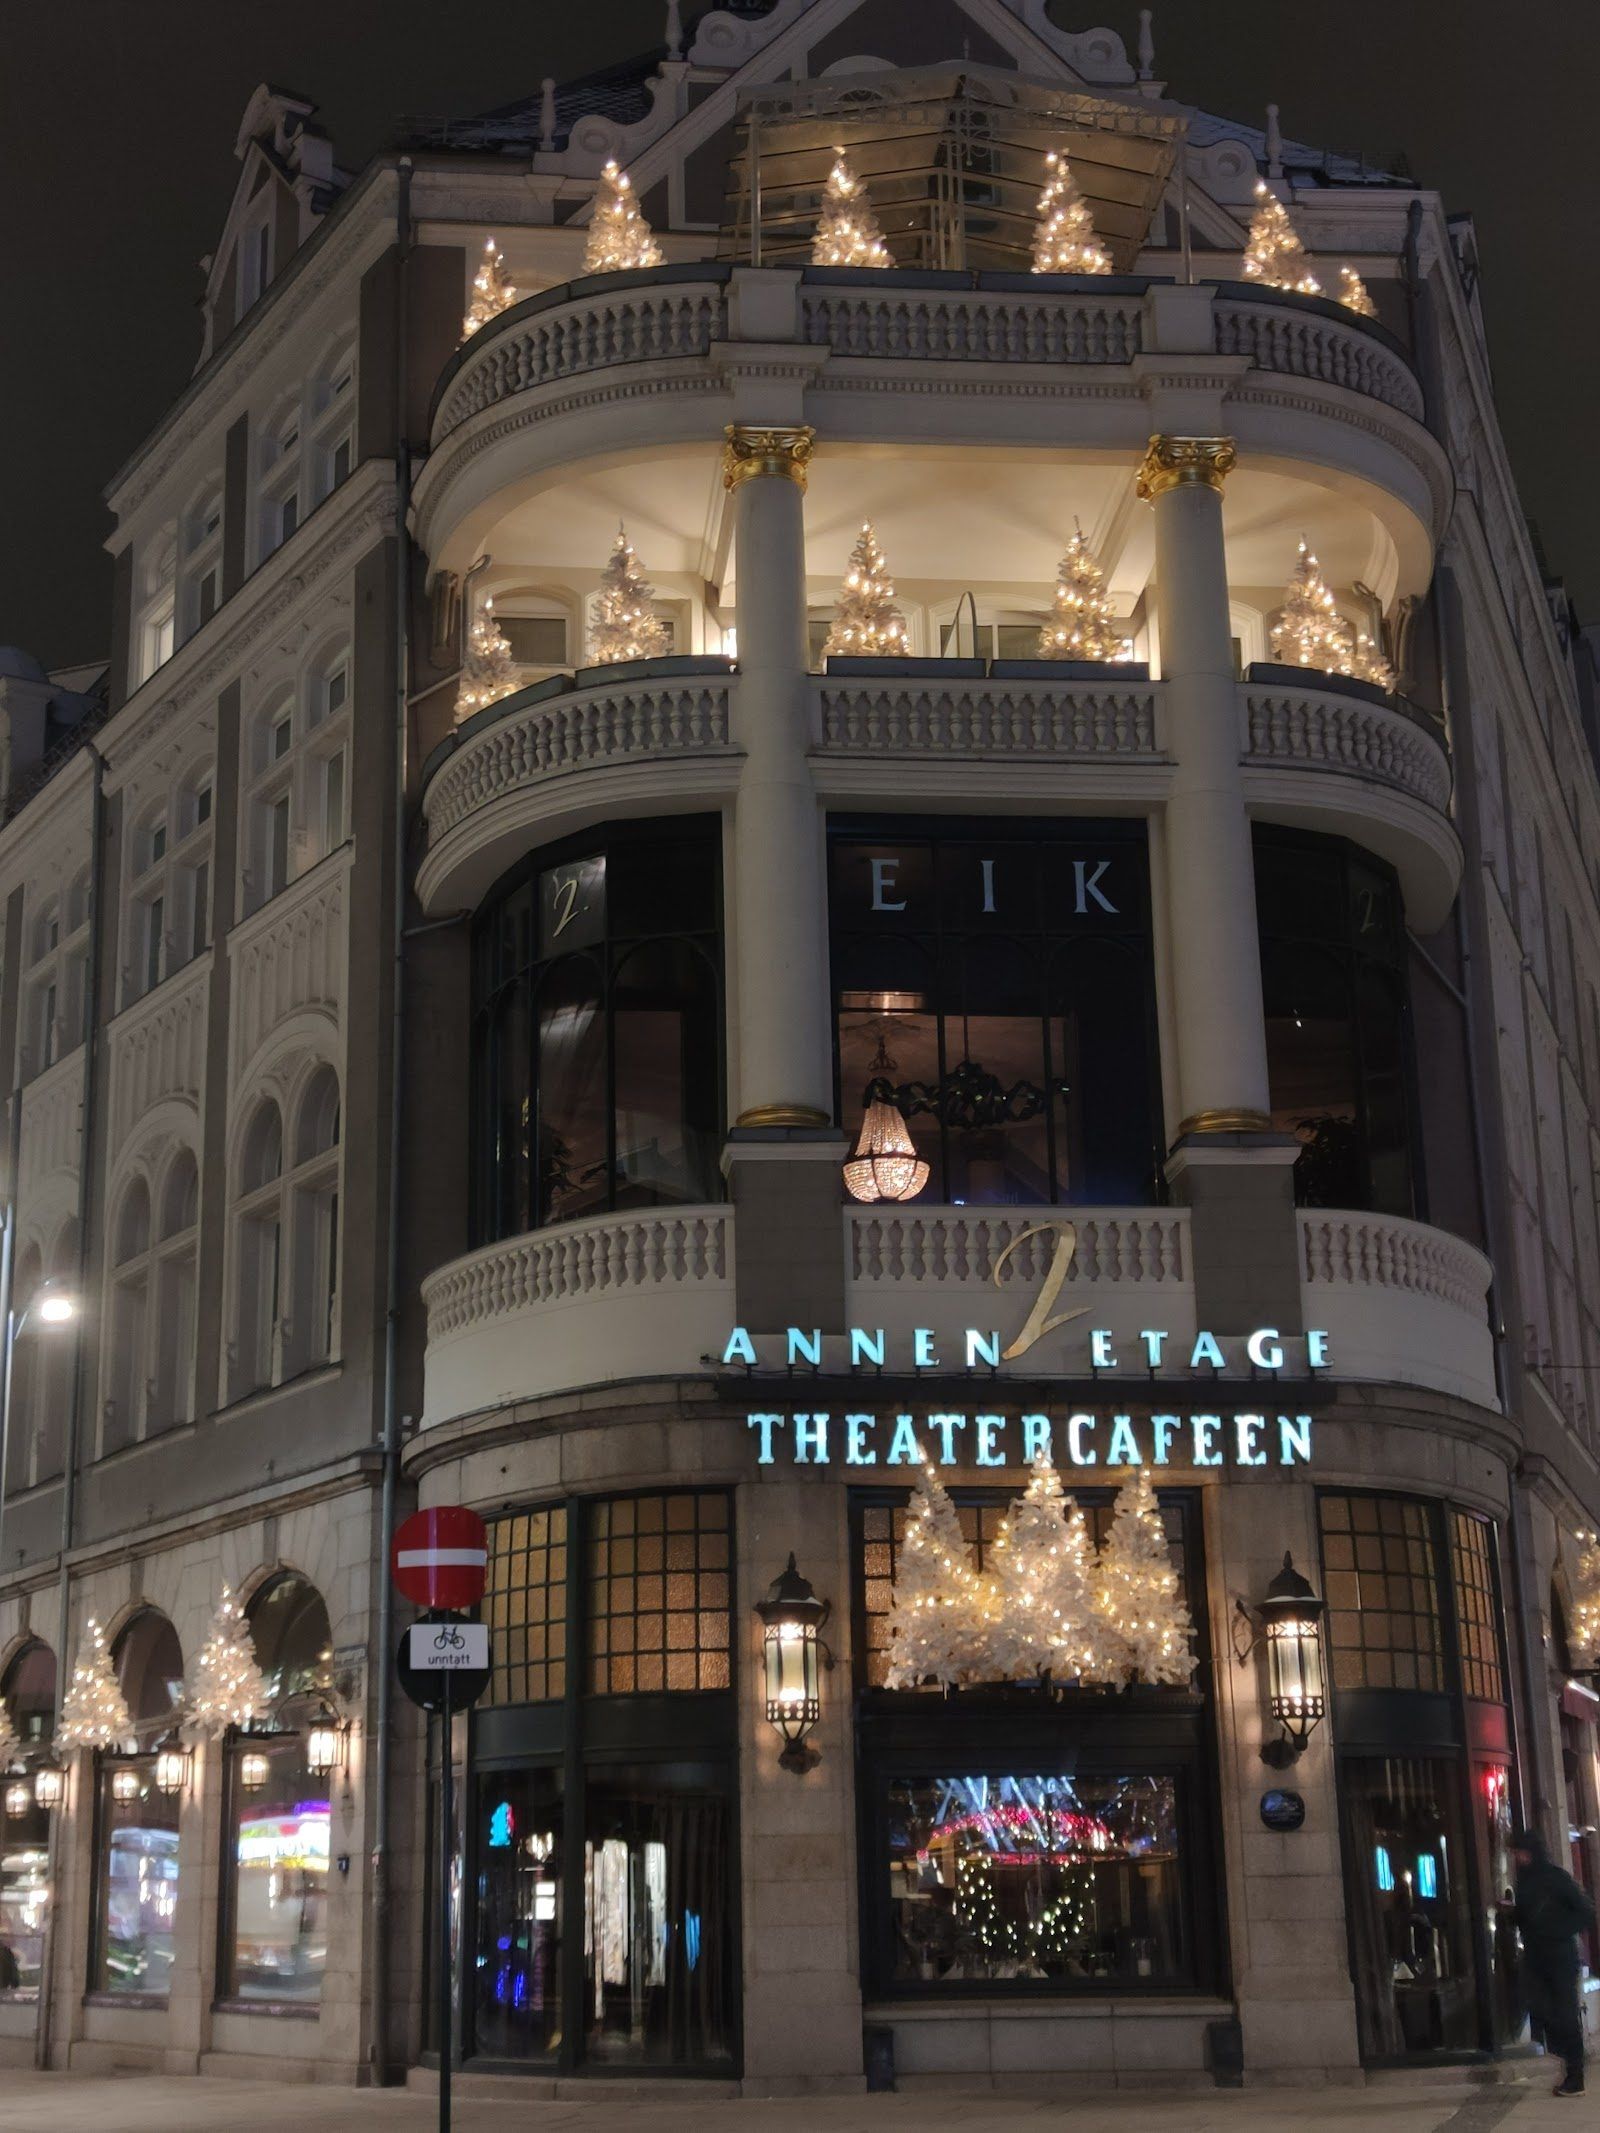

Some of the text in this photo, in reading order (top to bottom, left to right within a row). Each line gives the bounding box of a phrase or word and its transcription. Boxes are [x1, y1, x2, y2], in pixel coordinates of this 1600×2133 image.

[993, 1220, 1095, 1361] 2
[722, 1326, 1336, 1370] ANNEN ETAGE
[747, 1412, 1313, 1467] THEATERCAFEEN
[427, 1653, 472, 1666] unntatt
